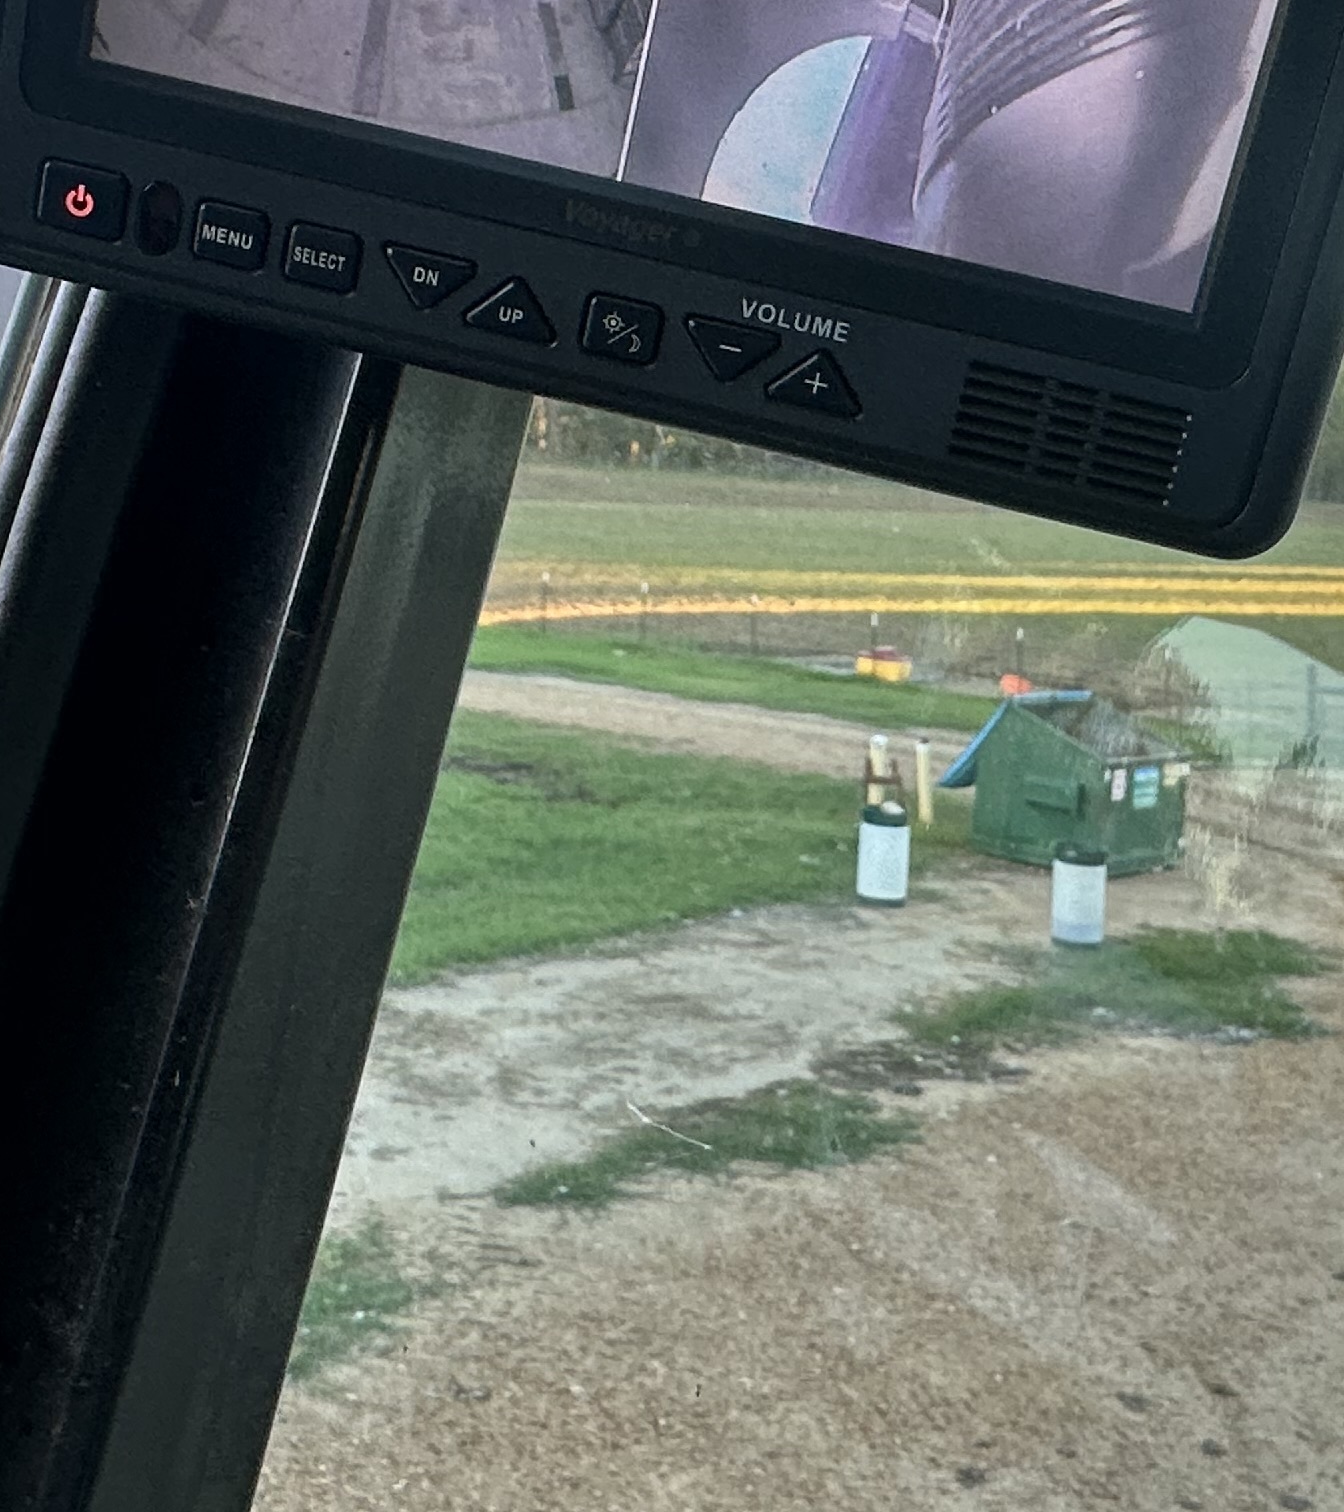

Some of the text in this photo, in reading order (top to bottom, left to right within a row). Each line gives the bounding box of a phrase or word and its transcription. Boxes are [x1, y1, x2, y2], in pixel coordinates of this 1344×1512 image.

[200, 223, 255, 251] MENU
[292, 245, 346, 274] SELECT
[412, 265, 440, 288] DN
[498, 305, 524, 326] UP
[739, 296, 851, 343] VOLUME
